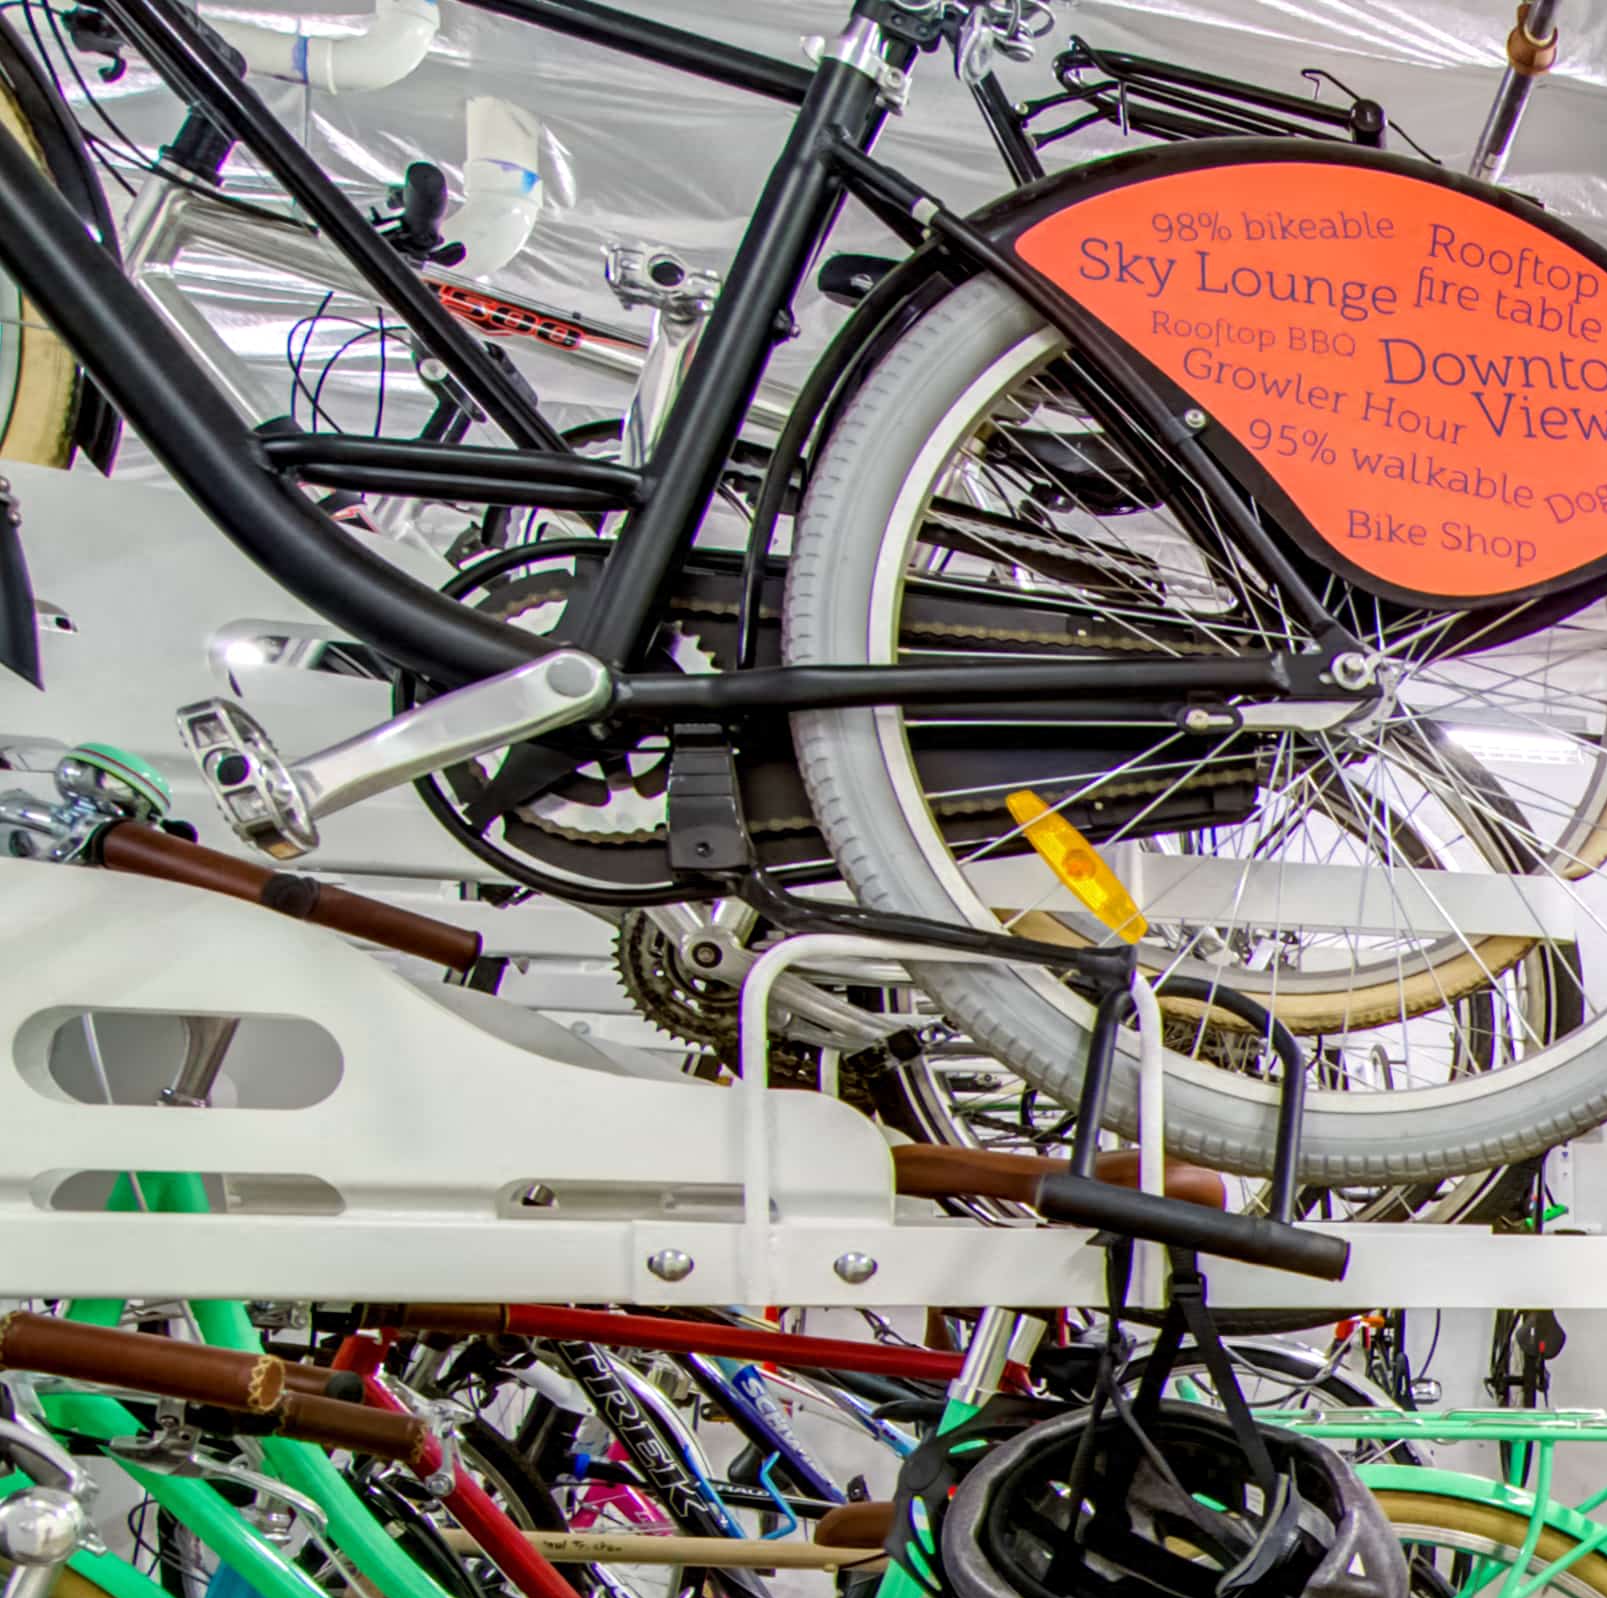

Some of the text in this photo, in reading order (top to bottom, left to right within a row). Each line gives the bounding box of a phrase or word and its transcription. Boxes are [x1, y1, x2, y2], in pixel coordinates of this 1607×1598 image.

[1152, 210, 1394, 243] 98% bikeable
[1428, 224, 1600, 302] Rooftop
[1080, 238, 1397, 320] Sky Lounge
[1414, 266, 1602, 343] fire table
[1152, 310, 1356, 358] Rooftop BBQ
[1184, 349, 1467, 445] Growler Hour
[1249, 418, 1533, 508] 95% walkable
[1347, 509, 1536, 568] Bike Shop
[557, 1342, 710, 1518] TREK
